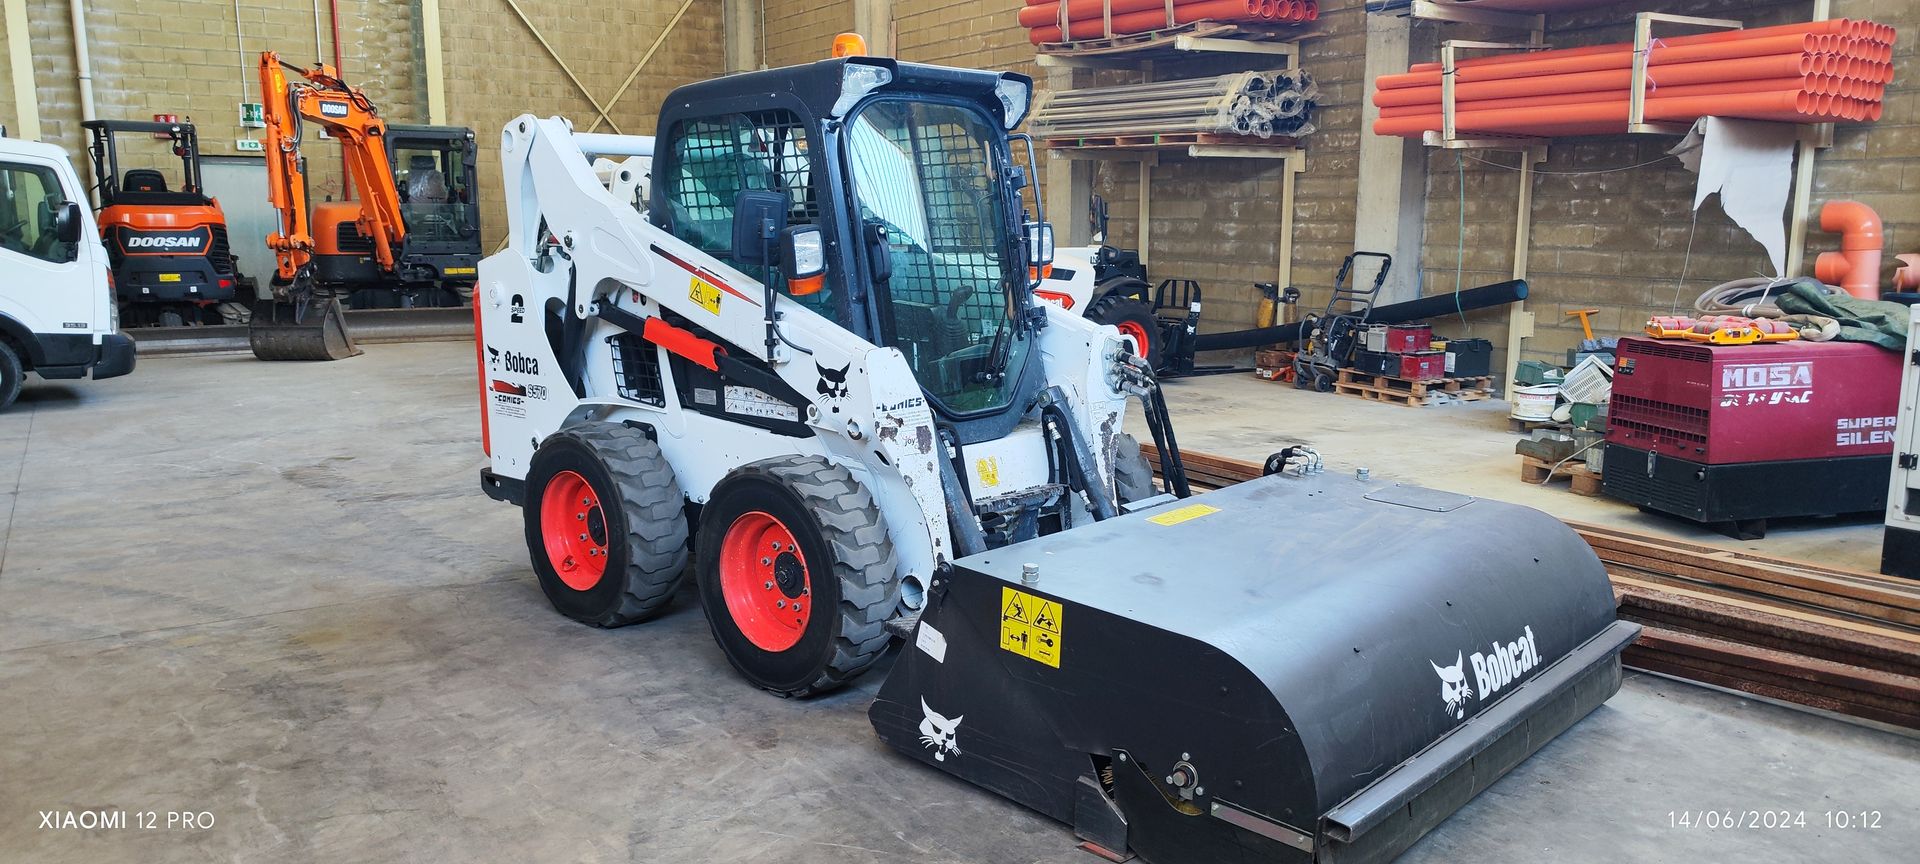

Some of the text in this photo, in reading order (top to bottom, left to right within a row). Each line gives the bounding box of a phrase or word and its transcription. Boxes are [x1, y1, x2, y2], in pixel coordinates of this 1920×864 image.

[321, 102, 347, 115] DOOSAN
[128, 236, 200, 247] DOOSAN
[1722, 366, 1812, 388] MOSA
[527, 383, 548, 400] S570
[1836, 416, 1897, 430] SUPER
[1469, 624, 1539, 701] Bobcat
